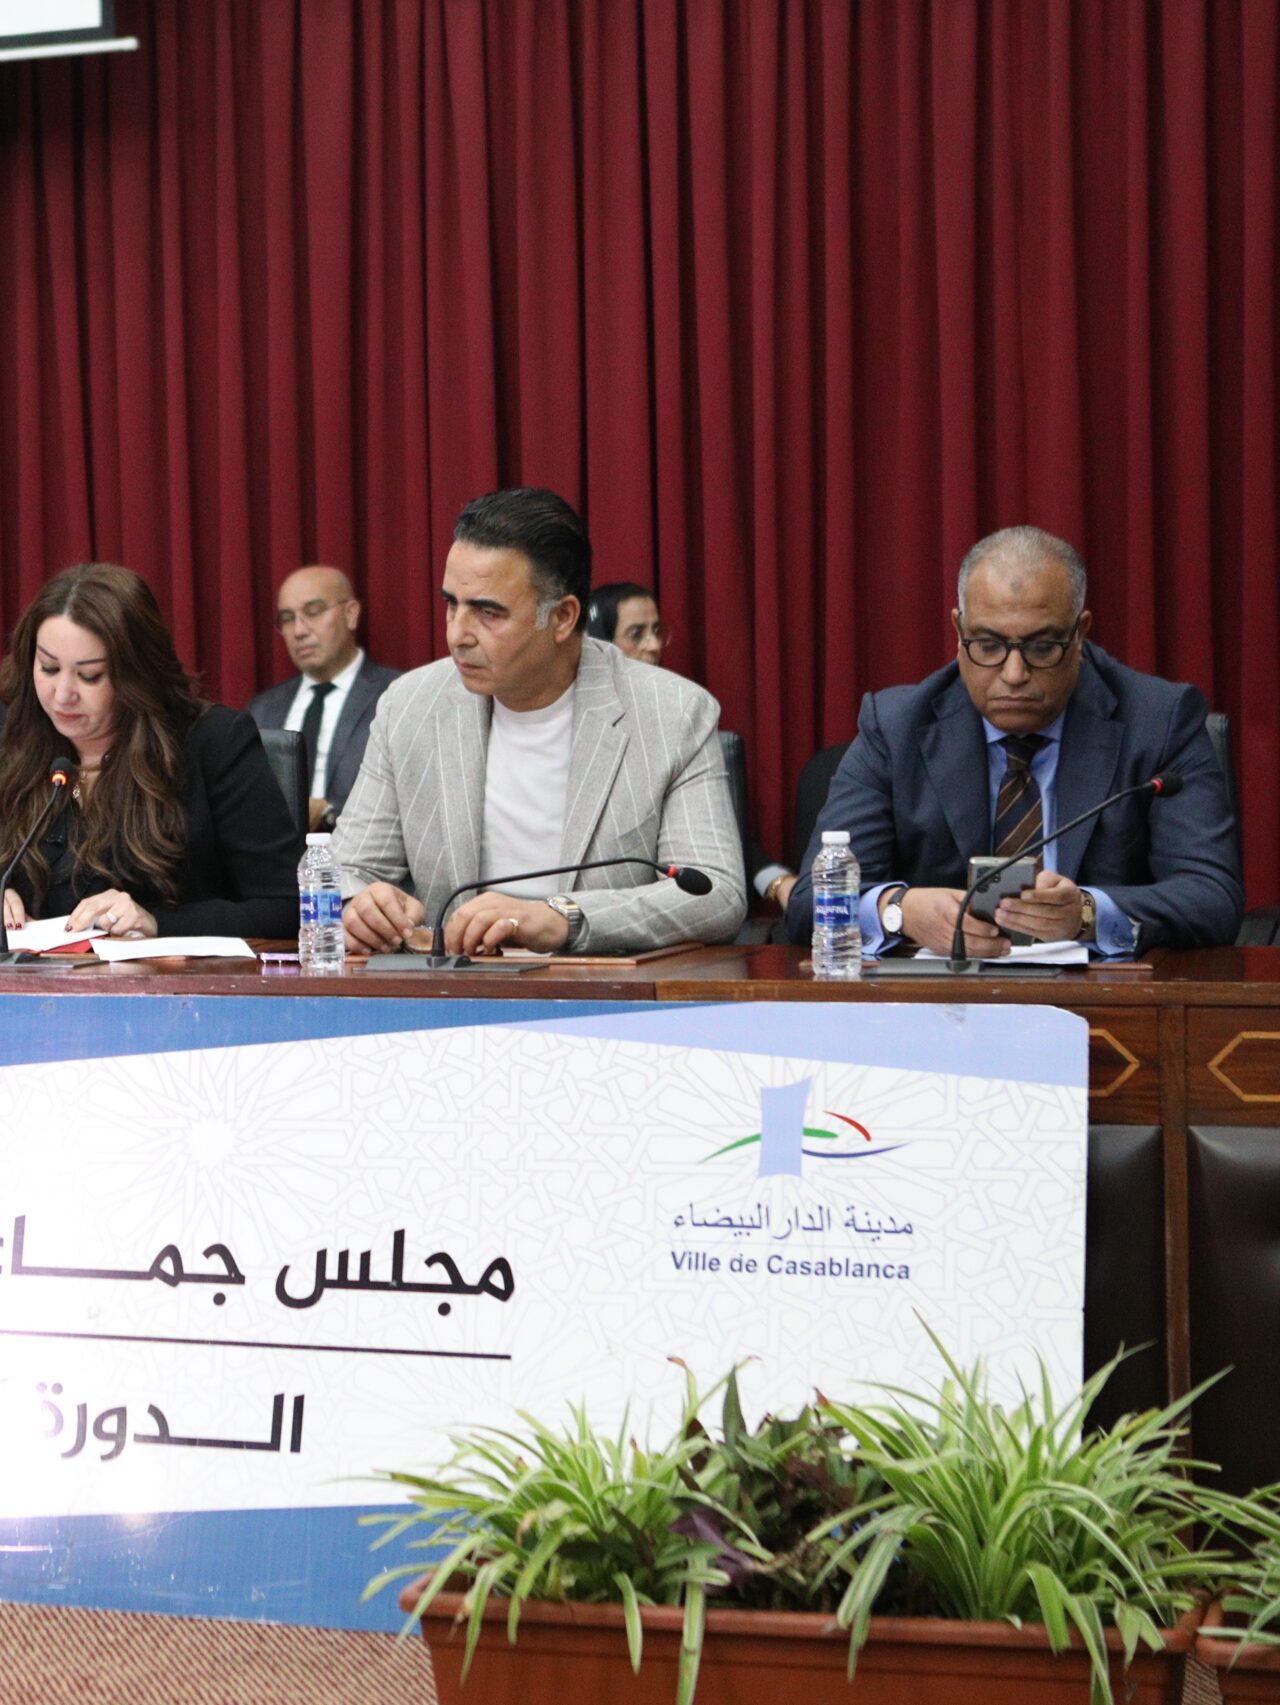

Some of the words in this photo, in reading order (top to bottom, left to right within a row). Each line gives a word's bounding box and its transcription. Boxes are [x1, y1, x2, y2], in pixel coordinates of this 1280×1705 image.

[673, 1202, 770, 1238] البيضاء
[772, 1205, 831, 1240] الدار
[844, 1205, 913, 1242] مدينة
[275, 1228, 515, 1317] مجلس
[670, 1251, 721, 1273] Ville
[729, 1253, 758, 1274] de
[767, 1254, 910, 1280] Casablanca
[40, 1382, 306, 1462] الدورة
